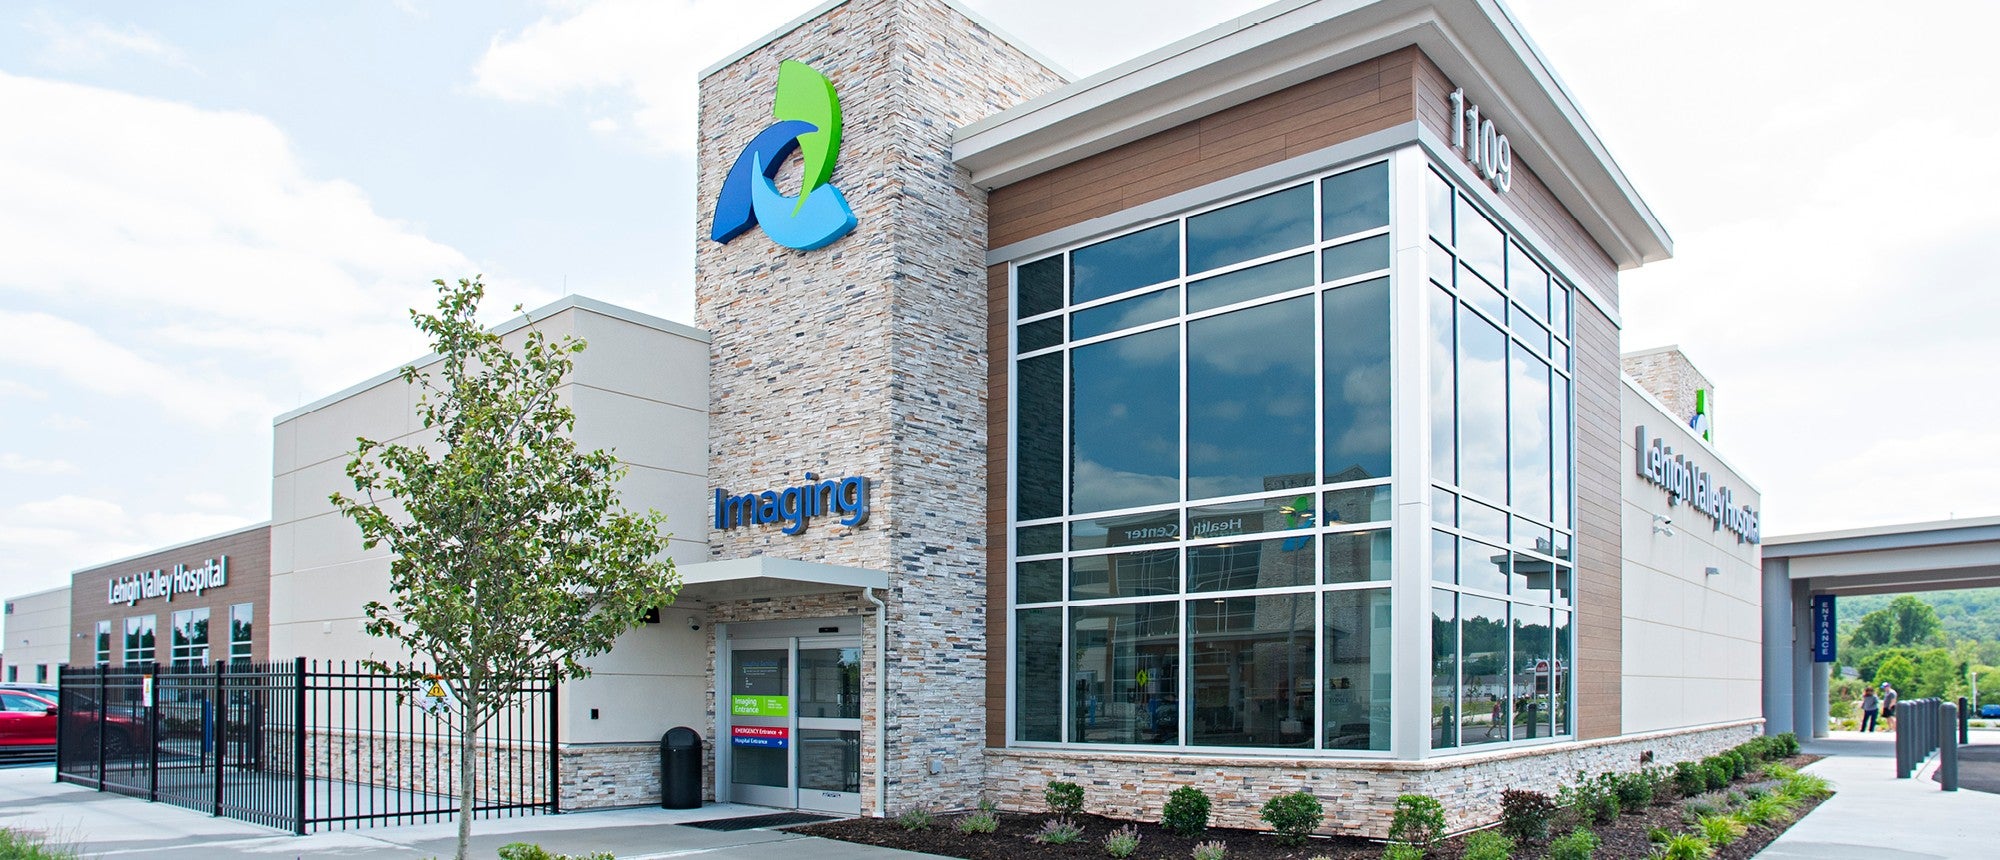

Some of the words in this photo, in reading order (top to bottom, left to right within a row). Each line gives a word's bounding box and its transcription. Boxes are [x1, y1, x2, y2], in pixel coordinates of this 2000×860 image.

[1450, 87, 1511, 193] 1109
[715, 472, 868, 535] Imaging
[1636, 425, 1692, 506] Lehigh
[1687, 461, 1725, 531] Valley
[108, 573, 140, 606] Lehigh
[141, 569, 173, 602] Valley
[174, 555, 226, 596] Hospital
[1821, 601, 1830, 655] ENTRANCE
[735, 697, 757, 707] Imaging
[735, 705, 759, 713] Entrance
